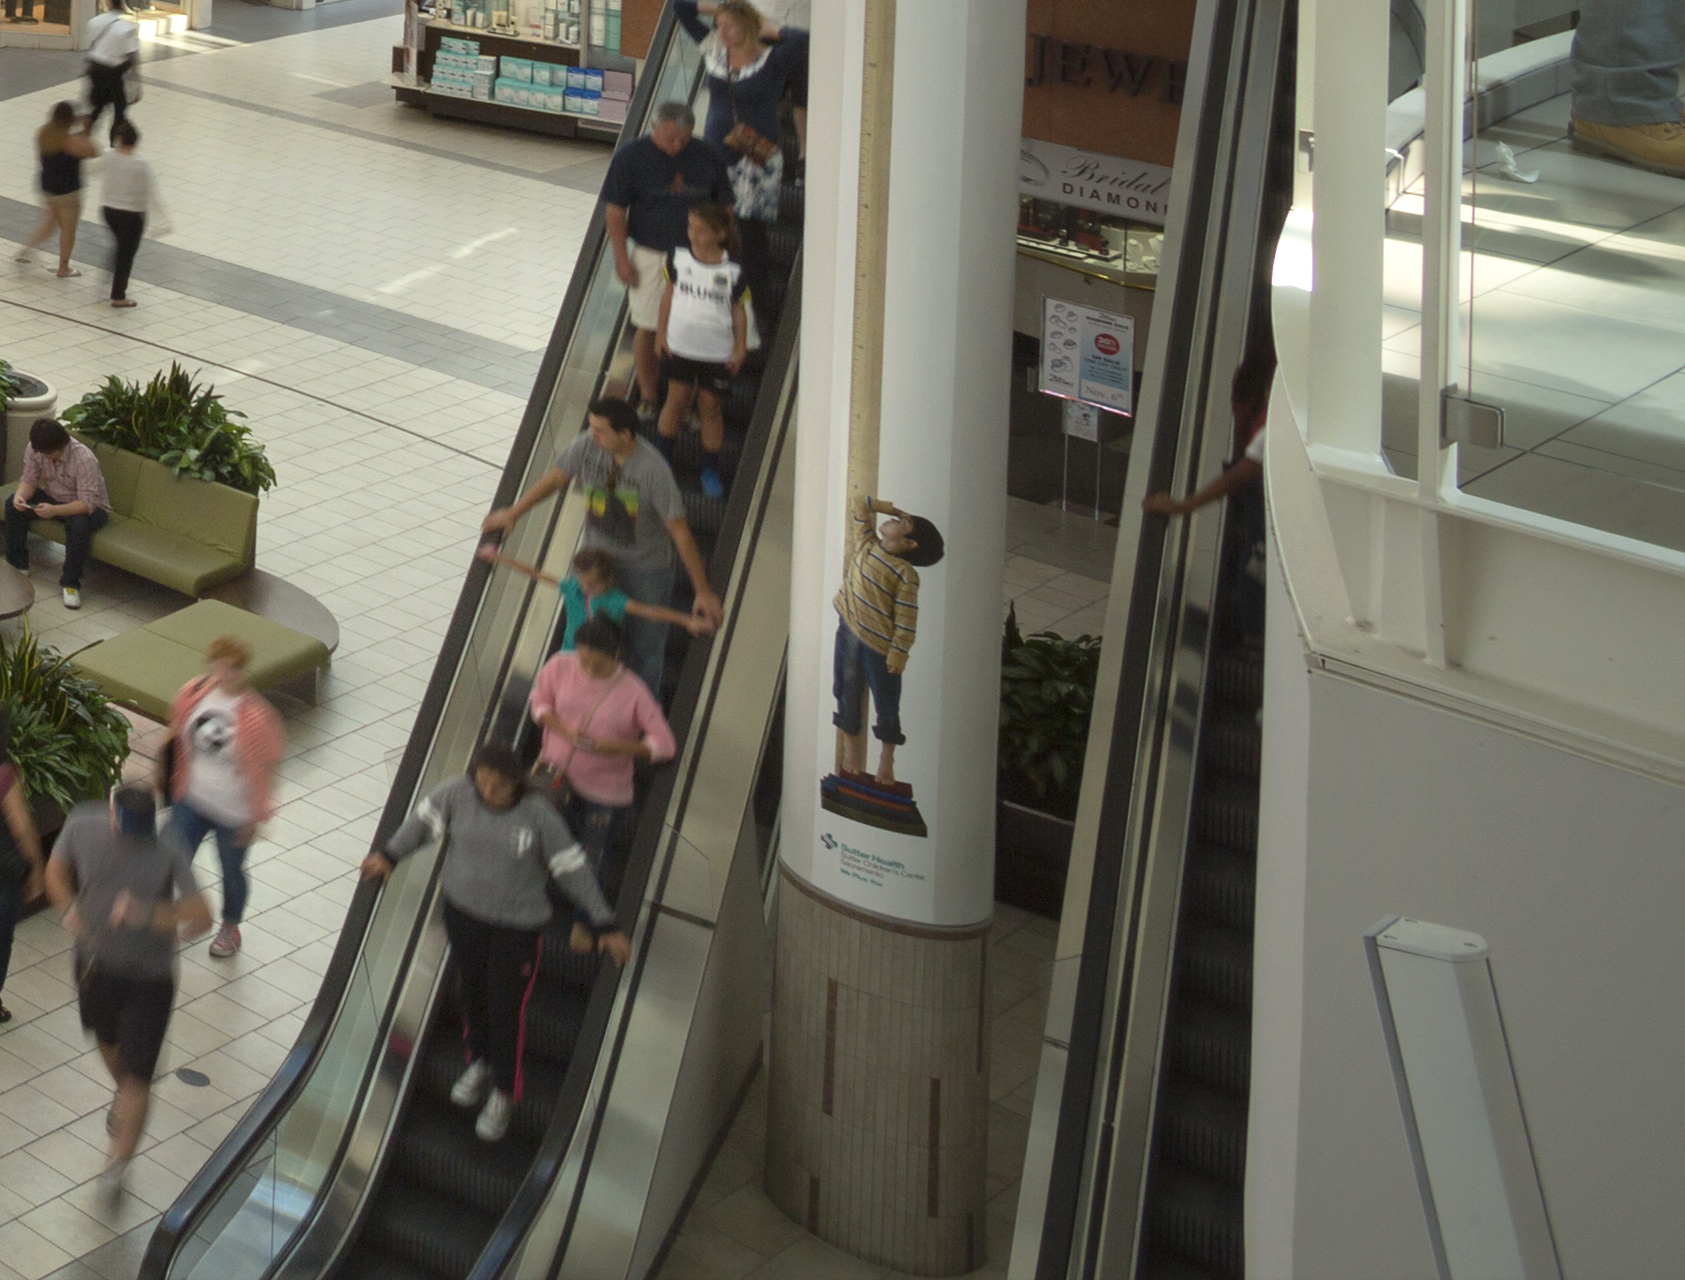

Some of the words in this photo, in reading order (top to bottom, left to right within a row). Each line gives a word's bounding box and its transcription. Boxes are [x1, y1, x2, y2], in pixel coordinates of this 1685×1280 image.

[1061, 154, 1171, 196] Bridal
[840, 843, 871, 860] Sutter
[871, 853, 905, 870] Health
